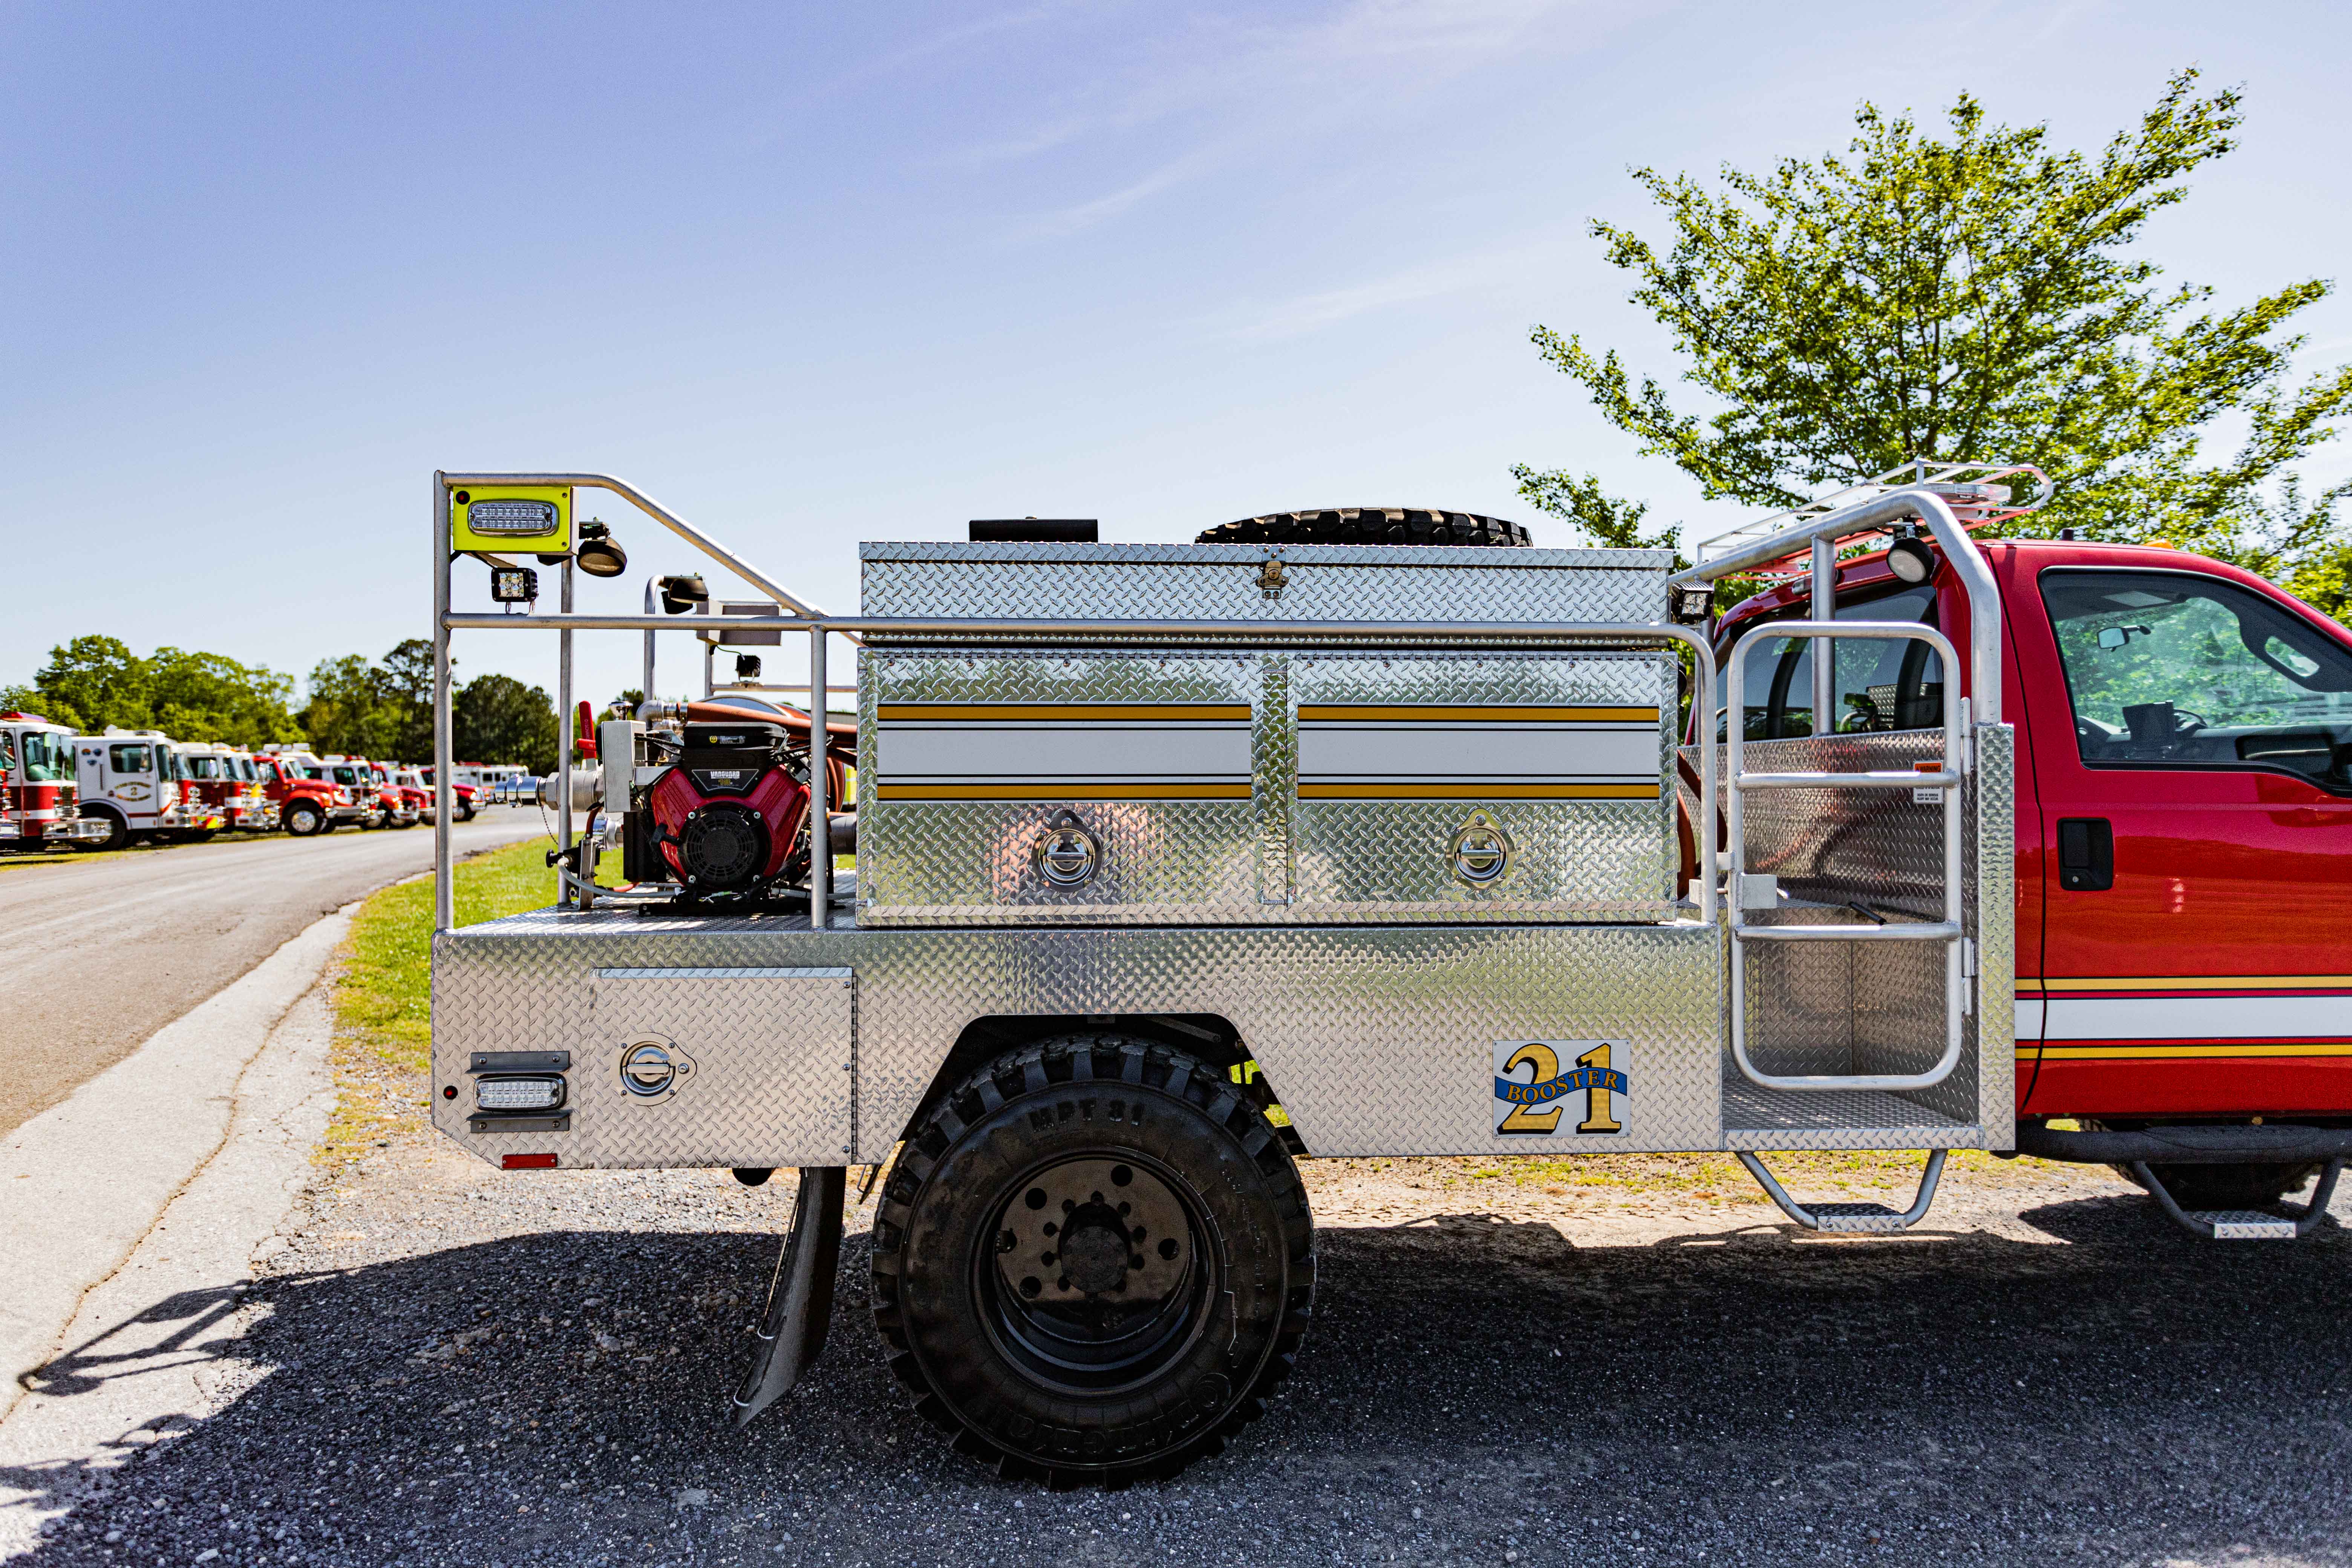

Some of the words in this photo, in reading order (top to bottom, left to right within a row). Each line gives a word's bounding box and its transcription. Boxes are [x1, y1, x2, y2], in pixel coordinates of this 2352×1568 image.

[130, 787, 138, 796] 2
[1496, 1043, 1622, 1135] 21
[1505, 1070, 1618, 1104] BOOSTER
[1029, 1098, 1096, 1132] MPT
